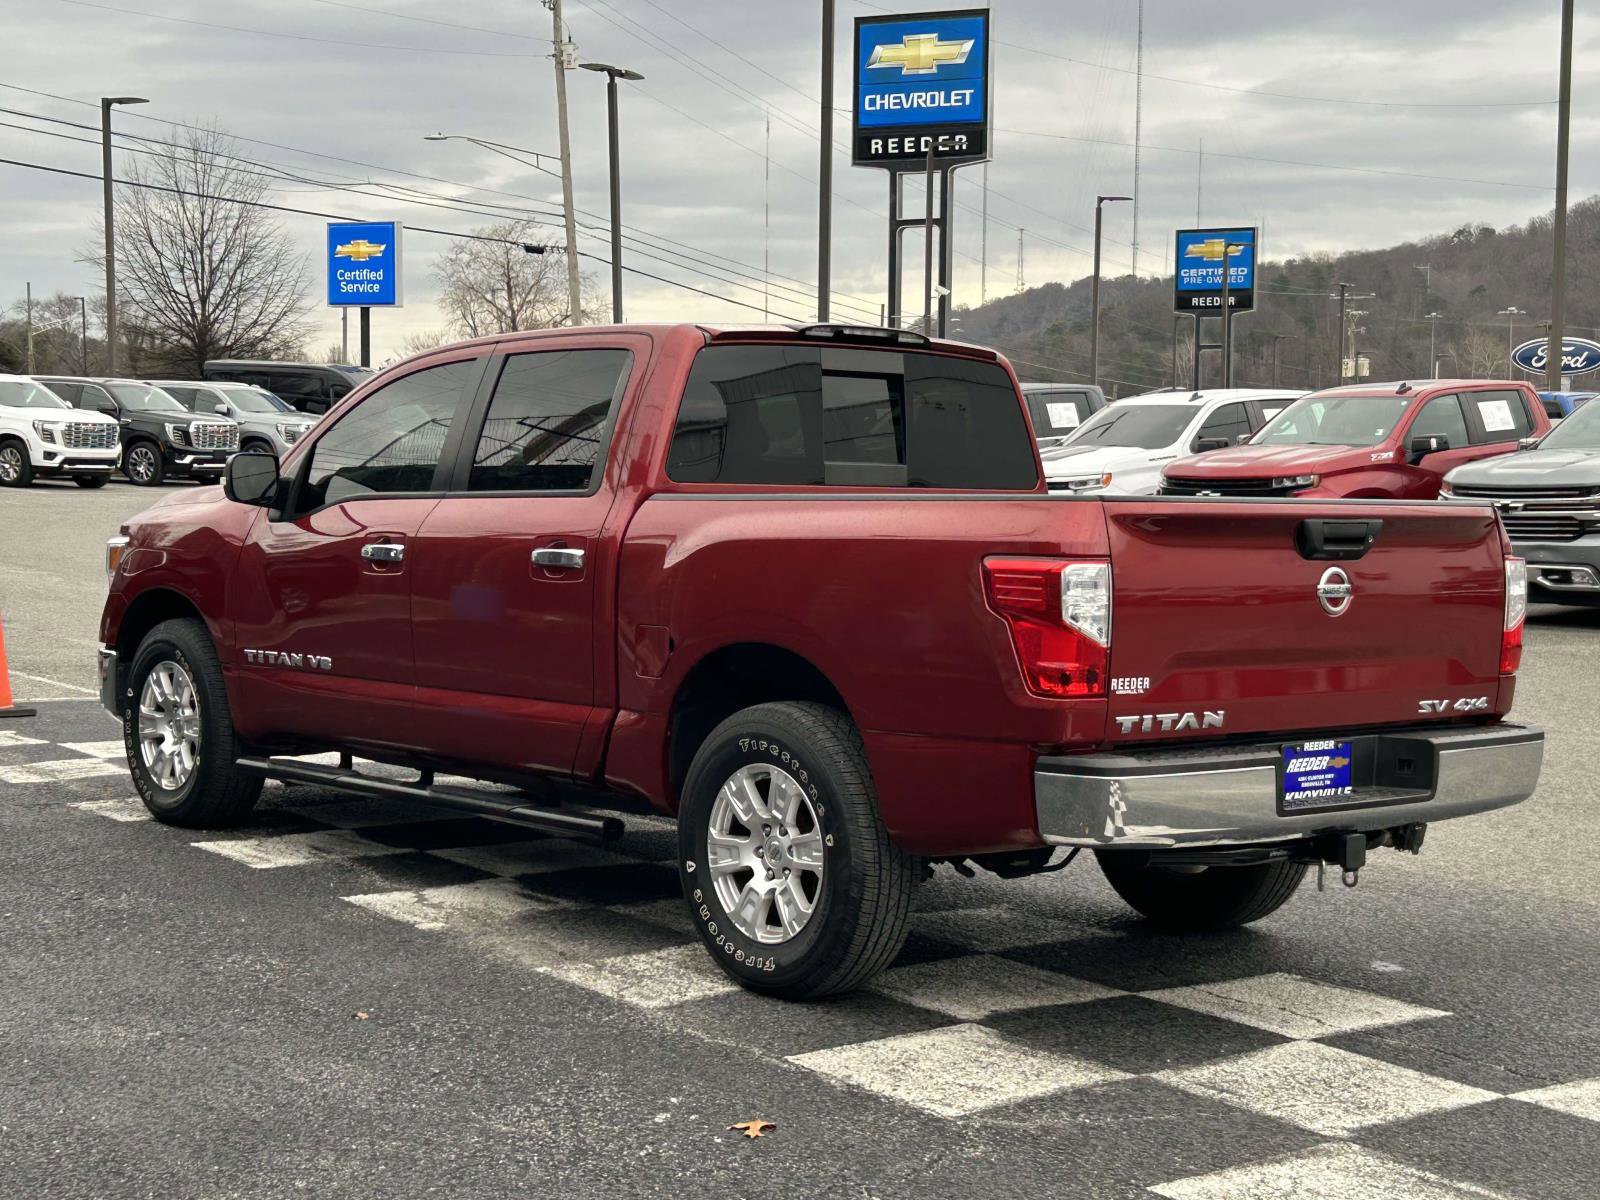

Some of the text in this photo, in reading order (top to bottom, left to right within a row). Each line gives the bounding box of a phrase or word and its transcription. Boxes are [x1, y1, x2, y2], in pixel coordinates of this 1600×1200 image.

[864, 89, 974, 111] CHEVROLET
[870, 134, 968, 154] REEDER
[336, 268, 384, 280] Certified
[1180, 267, 1248, 277] CERTIFED
[1183, 275, 1244, 284] PRE-OWED
[340, 281, 380, 293] Service
[1191, 296, 1235, 307] REEDR
[1531, 345, 1589, 368] Frd
[244, 649, 332, 670] TITAN V8
[1111, 677, 1150, 691] REEDER
[1418, 699, 1449, 712] SV
[1115, 710, 1225, 734] TITAN
[1303, 740, 1335, 751] REEDER
[1286, 756, 1330, 773] REEDER
